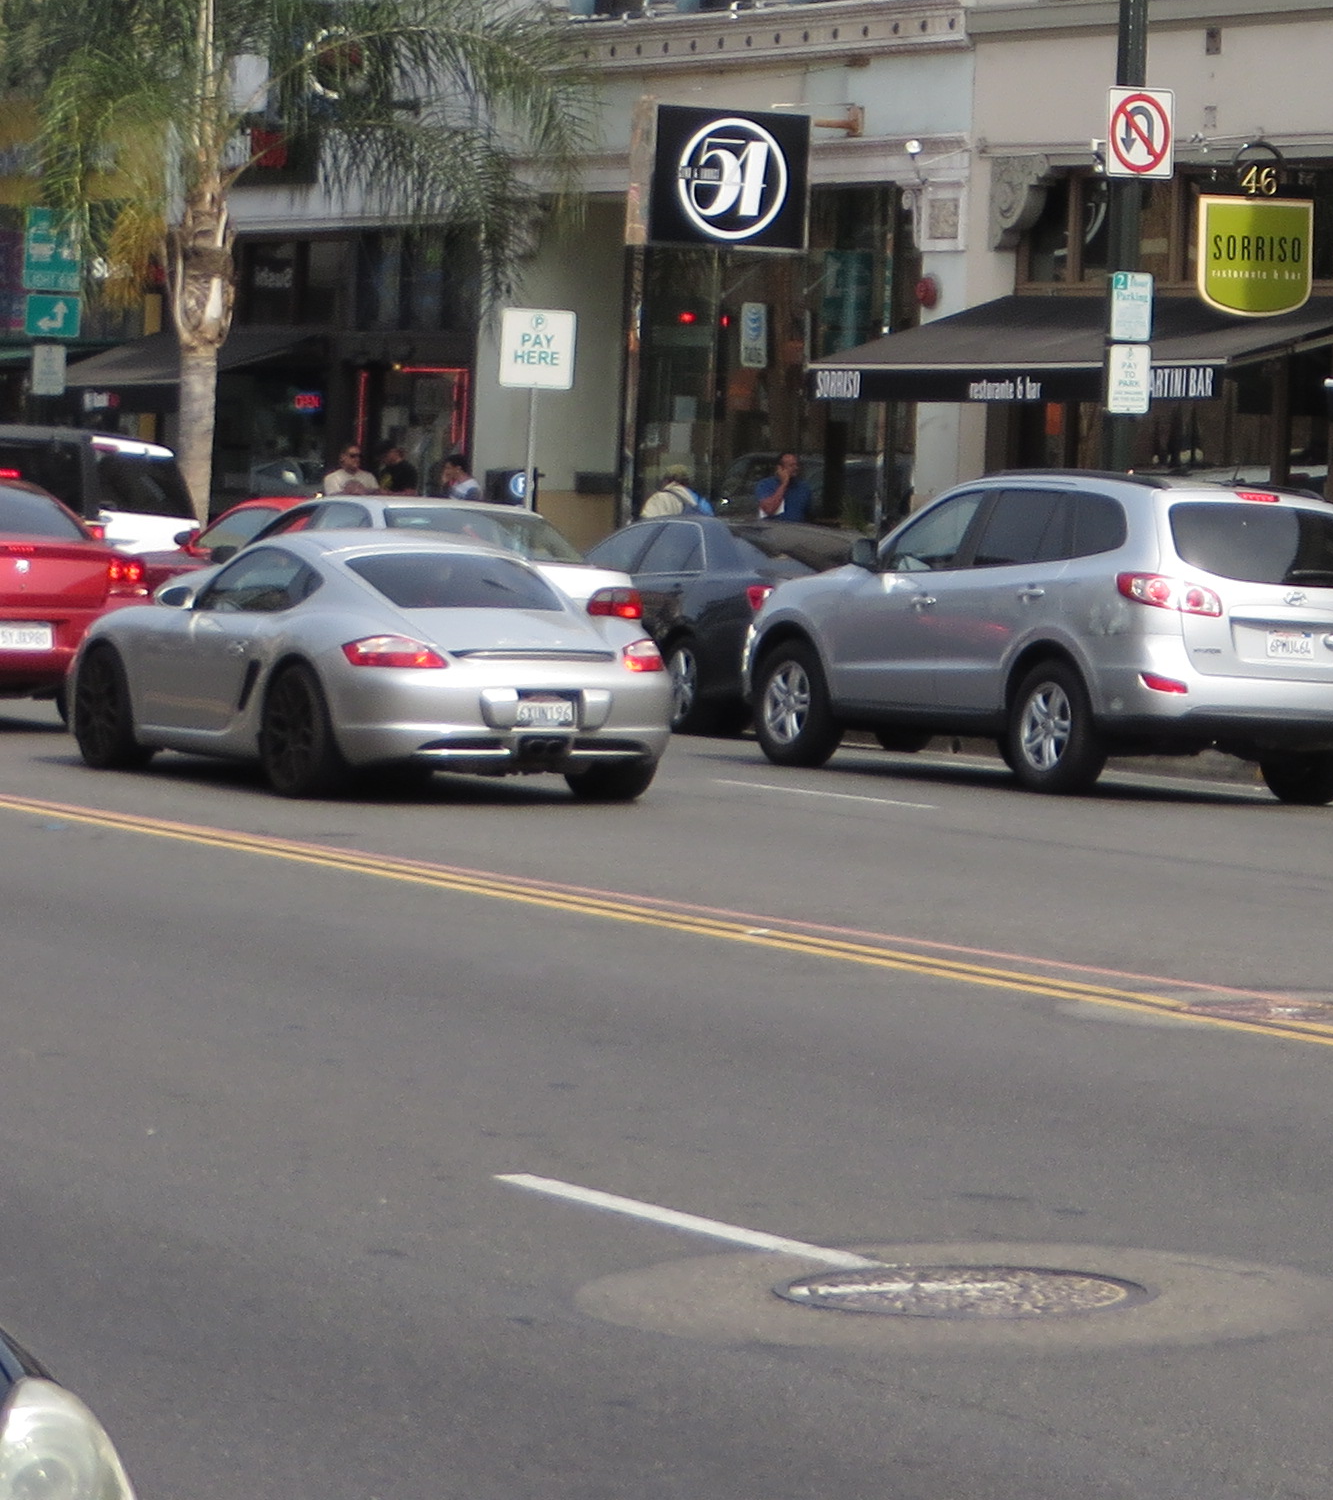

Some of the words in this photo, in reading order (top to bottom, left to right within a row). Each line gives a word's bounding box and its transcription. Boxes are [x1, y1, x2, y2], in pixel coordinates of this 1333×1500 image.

[1241, 165, 1278, 195] 46
[1213, 234, 1301, 263] SORRISO
[1116, 274, 1125, 288] 2
[1284, 270, 1301, 280] bar
[1116, 291, 1149, 304] Parking
[521, 333, 555, 348] PAY
[513, 350, 560, 366] HERE
[1124, 370, 1136, 378] TO
[815, 370, 861, 399] SORRISO
[1016, 376, 1023, 399] &
[1026, 374, 1041, 399] bar
[1149, 368, 1187, 398] ARTINI
[1189, 368, 1214, 397] BAR
[294, 394, 321, 409] OPEN
